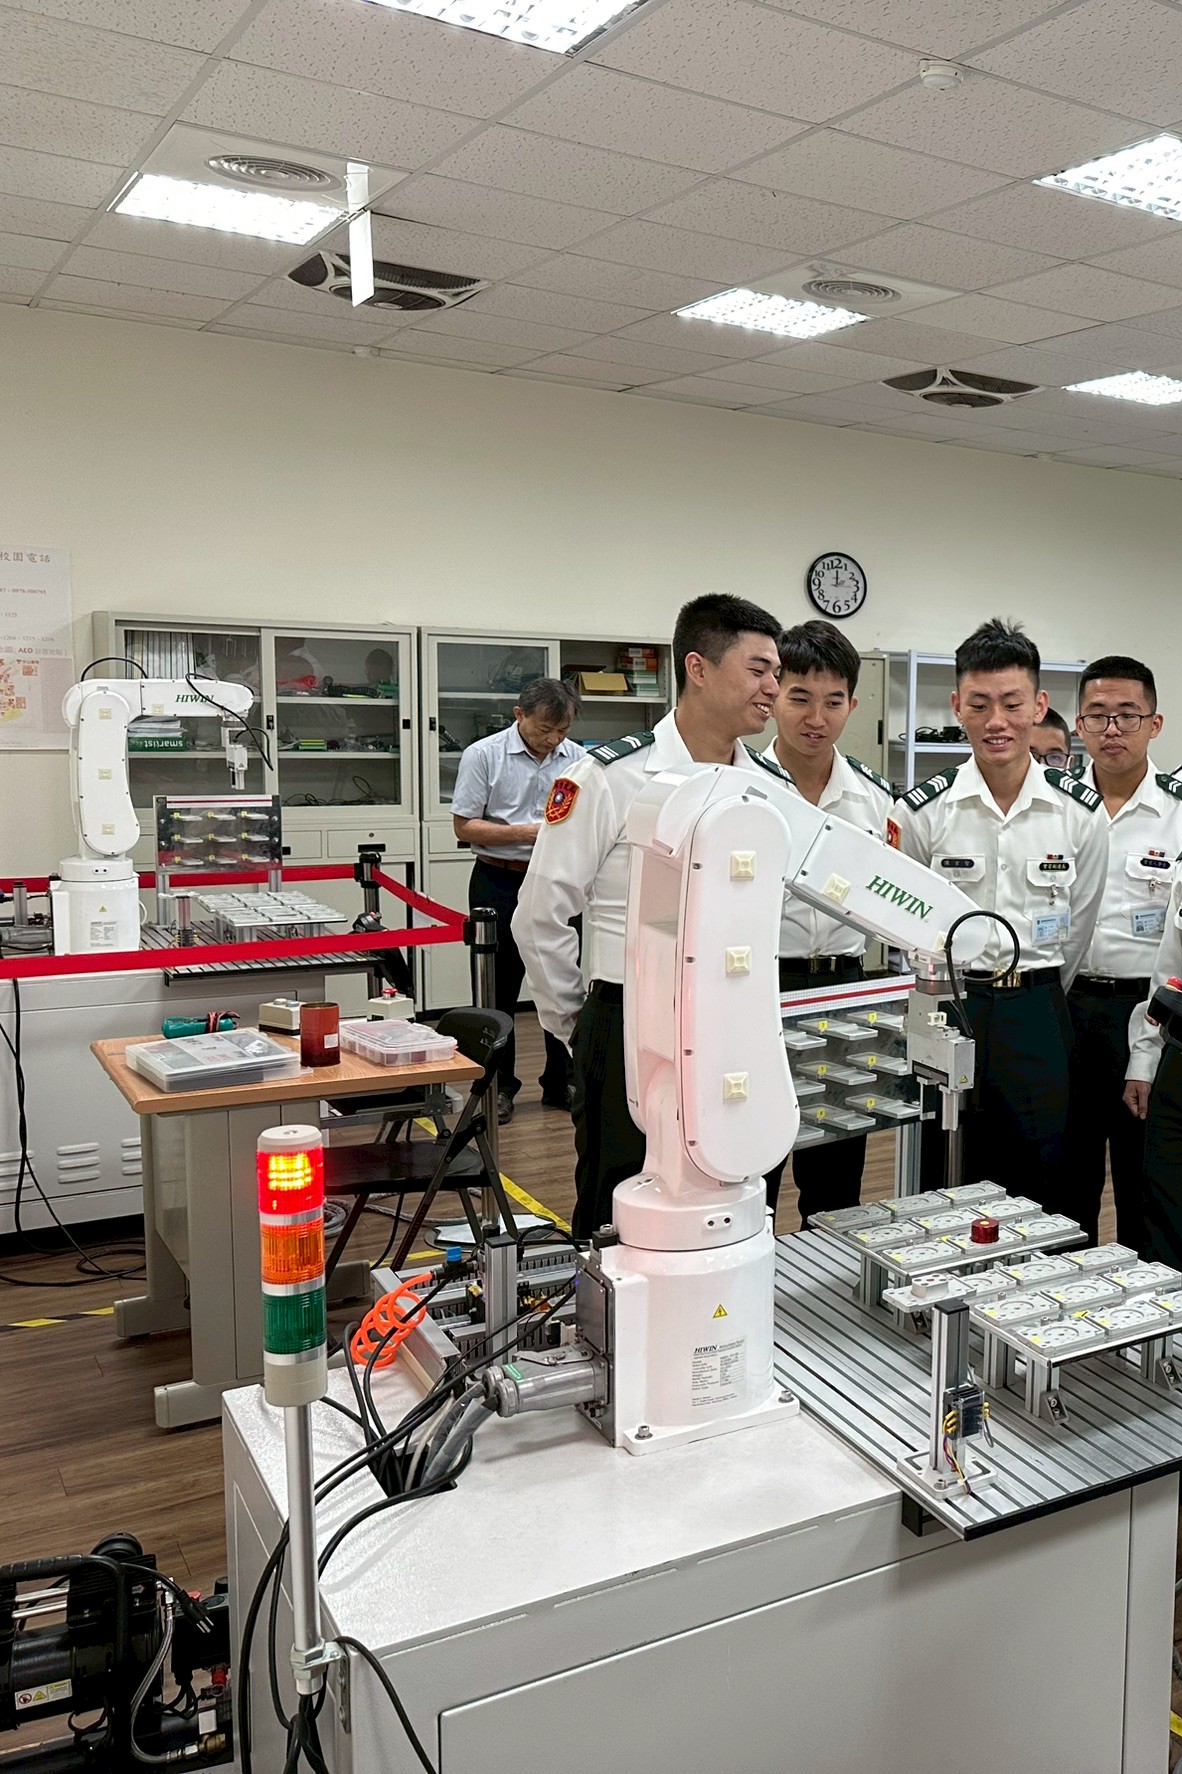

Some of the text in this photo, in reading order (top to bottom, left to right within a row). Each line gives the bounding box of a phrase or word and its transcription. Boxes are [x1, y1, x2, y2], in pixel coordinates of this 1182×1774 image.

[821, 561, 831, 571] 11
[829, 558, 843, 570] 12
[843, 562, 848, 571] 1
[814, 569, 825, 578] 10
[848, 571, 856, 580] 2
[812, 577, 821, 591] 9
[853, 579, 860, 593] 3
[817, 588, 825, 600] 8
[850, 592, 858, 603] 4
[822, 600, 830, 611] 7
[832, 600, 841, 613] 6
[843, 600, 850, 611] 5
[866, 875, 933, 919] HIWIN
[693, 1345, 718, 1354] HIWIN
